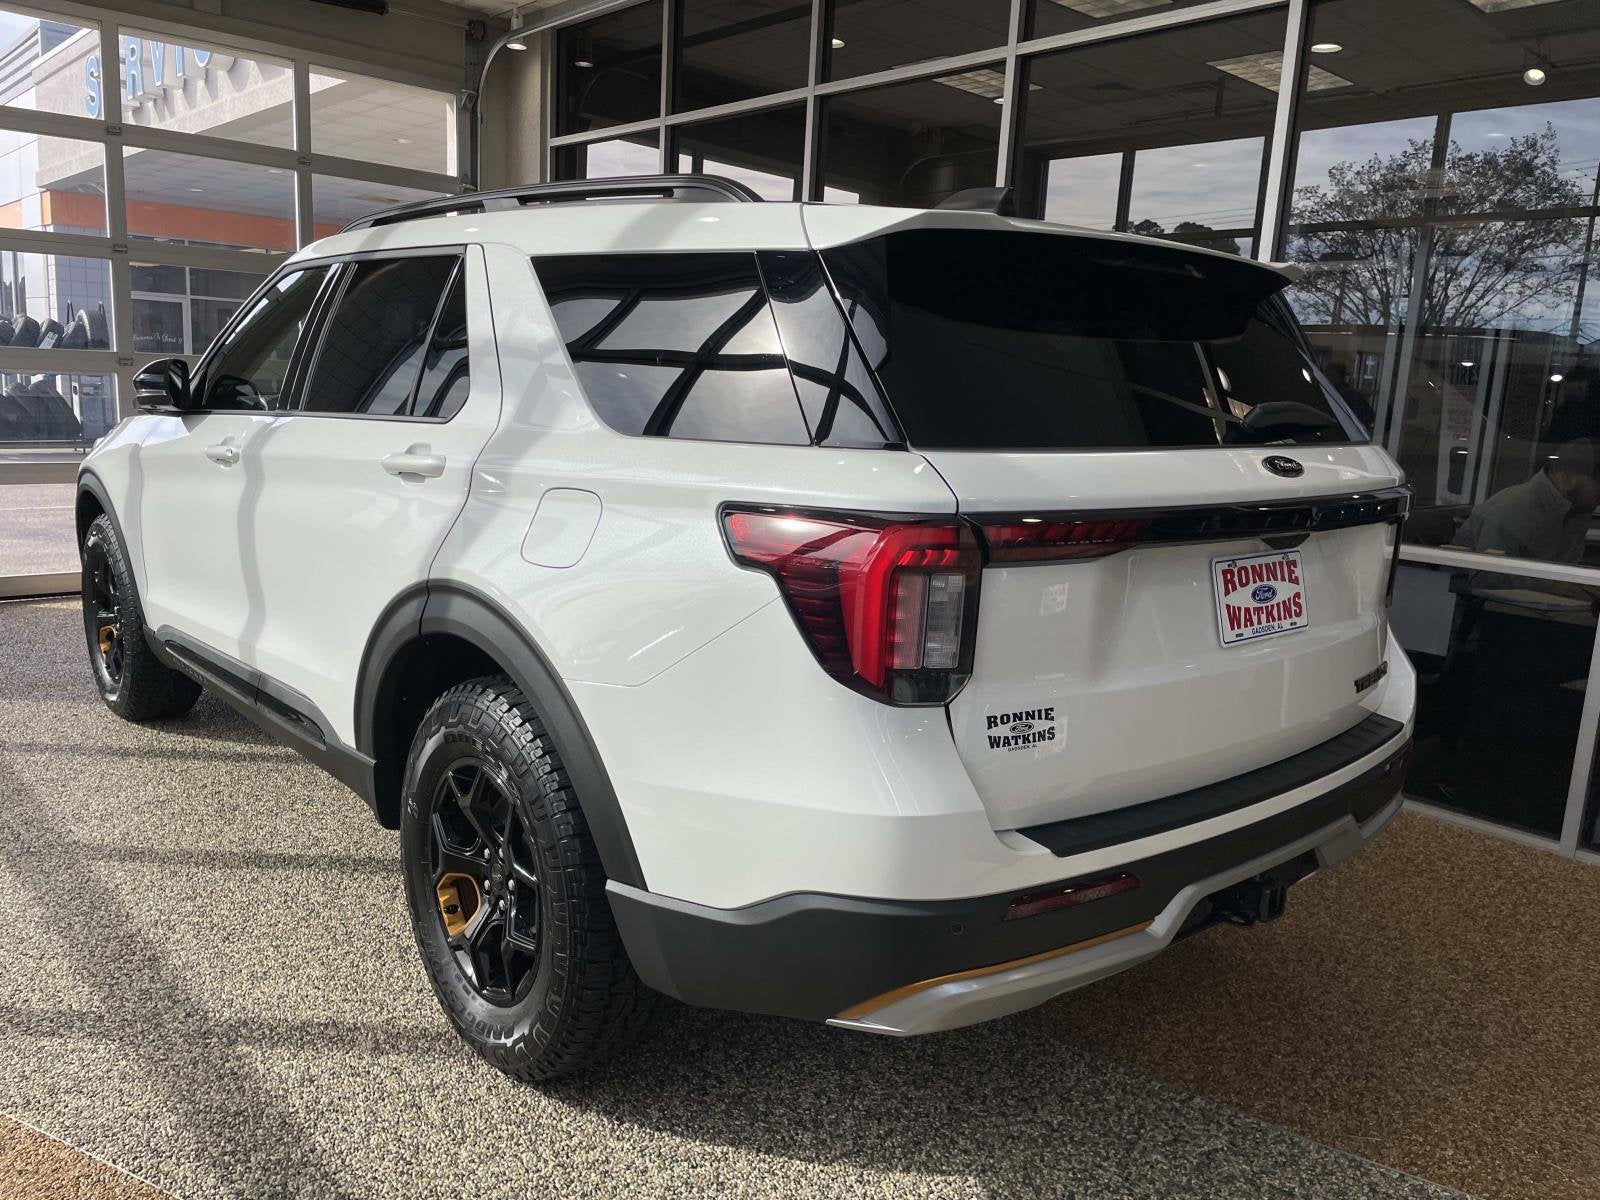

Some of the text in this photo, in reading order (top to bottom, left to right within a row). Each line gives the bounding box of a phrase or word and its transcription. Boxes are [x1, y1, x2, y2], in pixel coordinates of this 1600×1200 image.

[86, 34, 211, 119] SRVI
[1221, 559, 1300, 597] RONNIE
[1254, 588, 1274, 601] Ford
[1225, 592, 1303, 631] WATKINS
[986, 707, 1055, 730] RONNIE
[987, 726, 1056, 749] WATKINS
